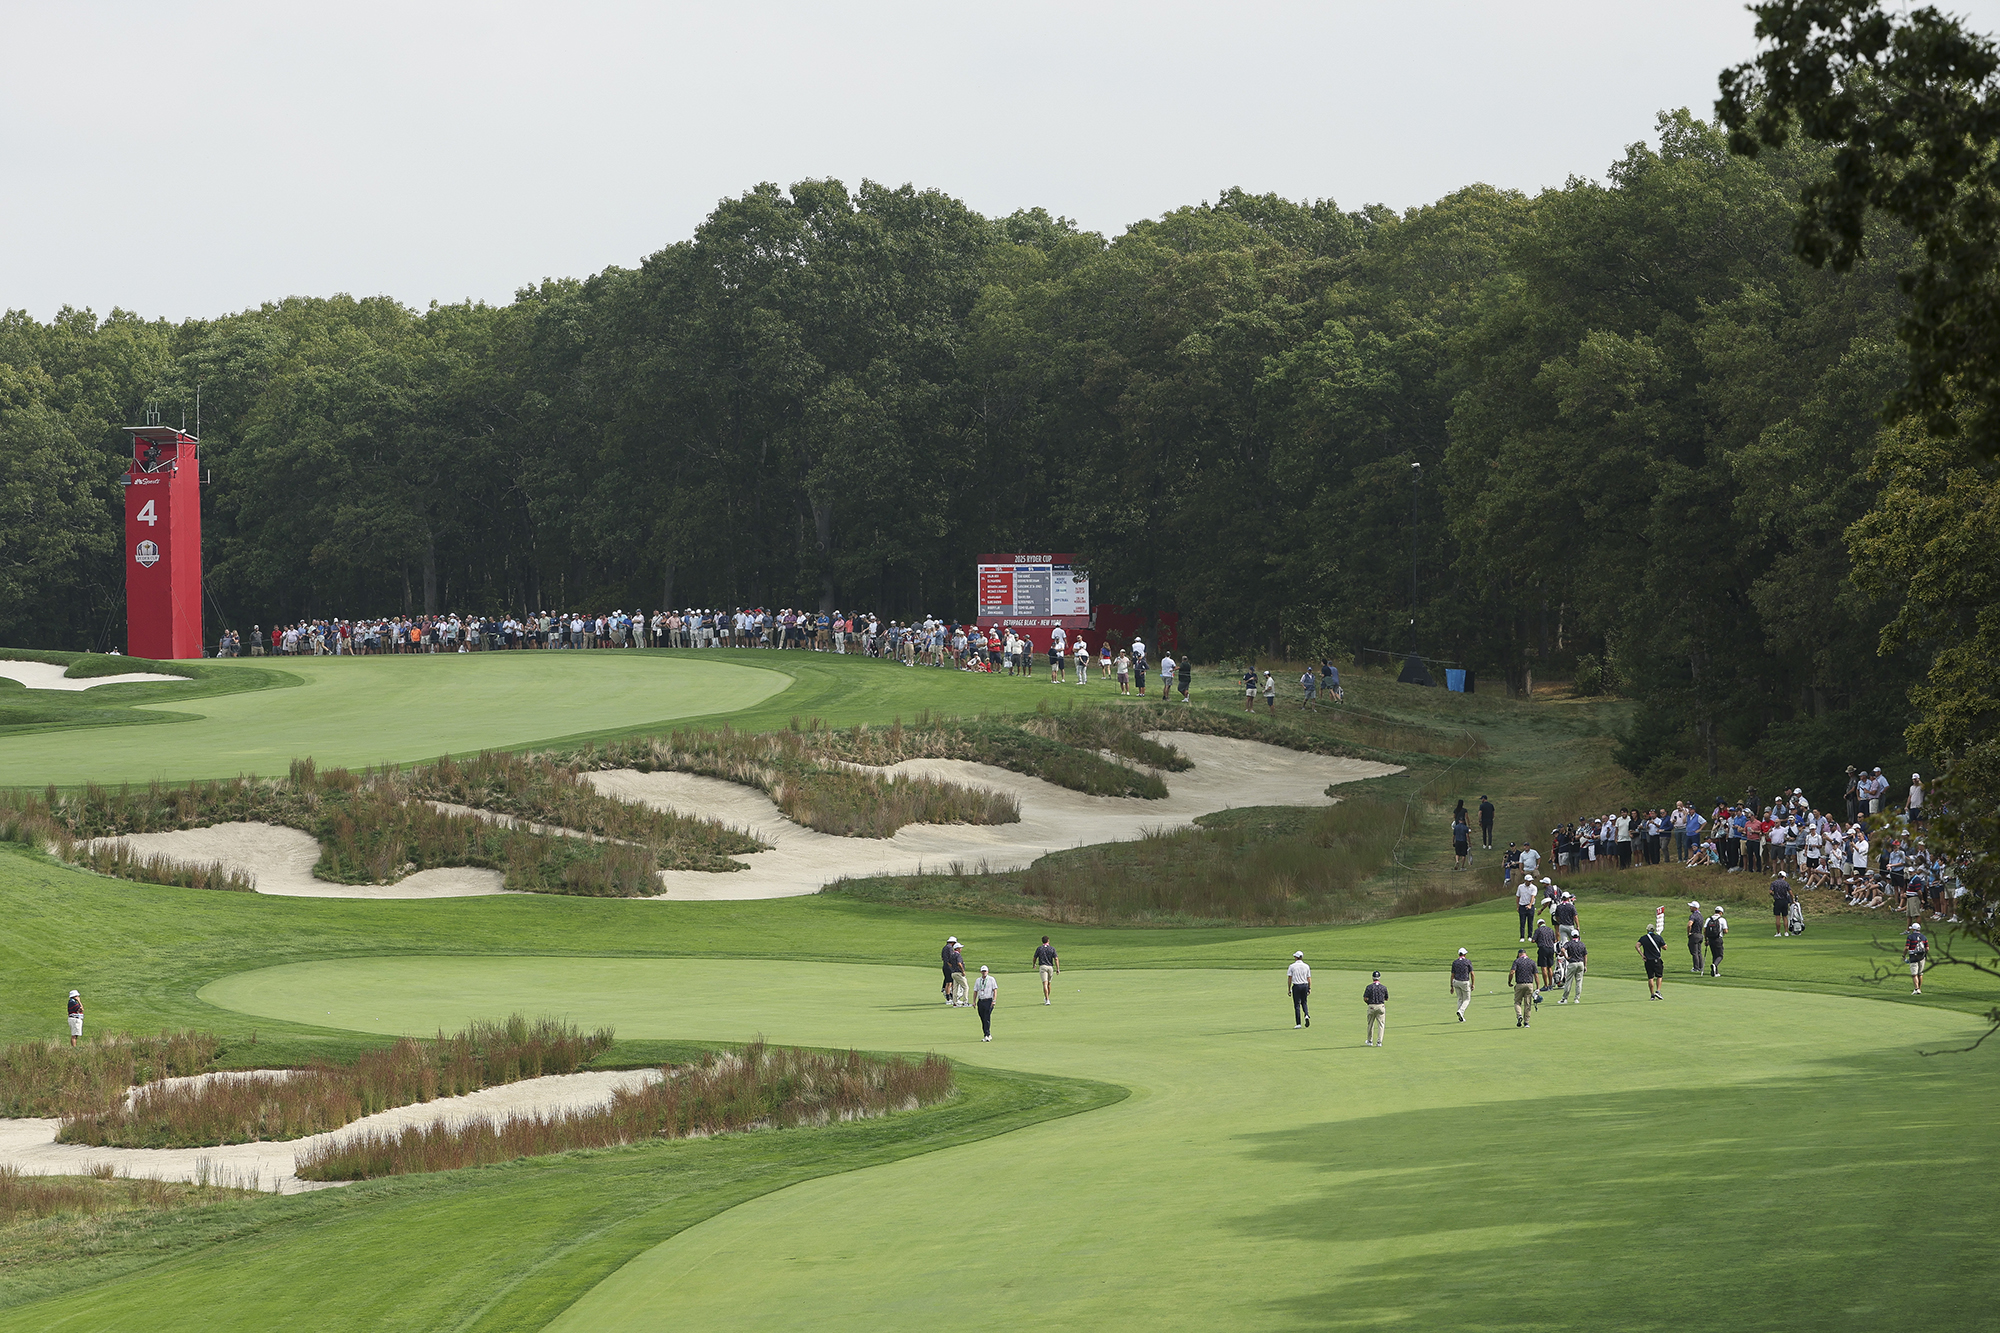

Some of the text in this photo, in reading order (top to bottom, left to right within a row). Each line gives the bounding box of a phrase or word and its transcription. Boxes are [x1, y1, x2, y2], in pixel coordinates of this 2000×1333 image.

[136, 499, 158, 527] 4
[1026, 555, 1042, 563] RYDER
[1042, 555, 1053, 563] CUP
